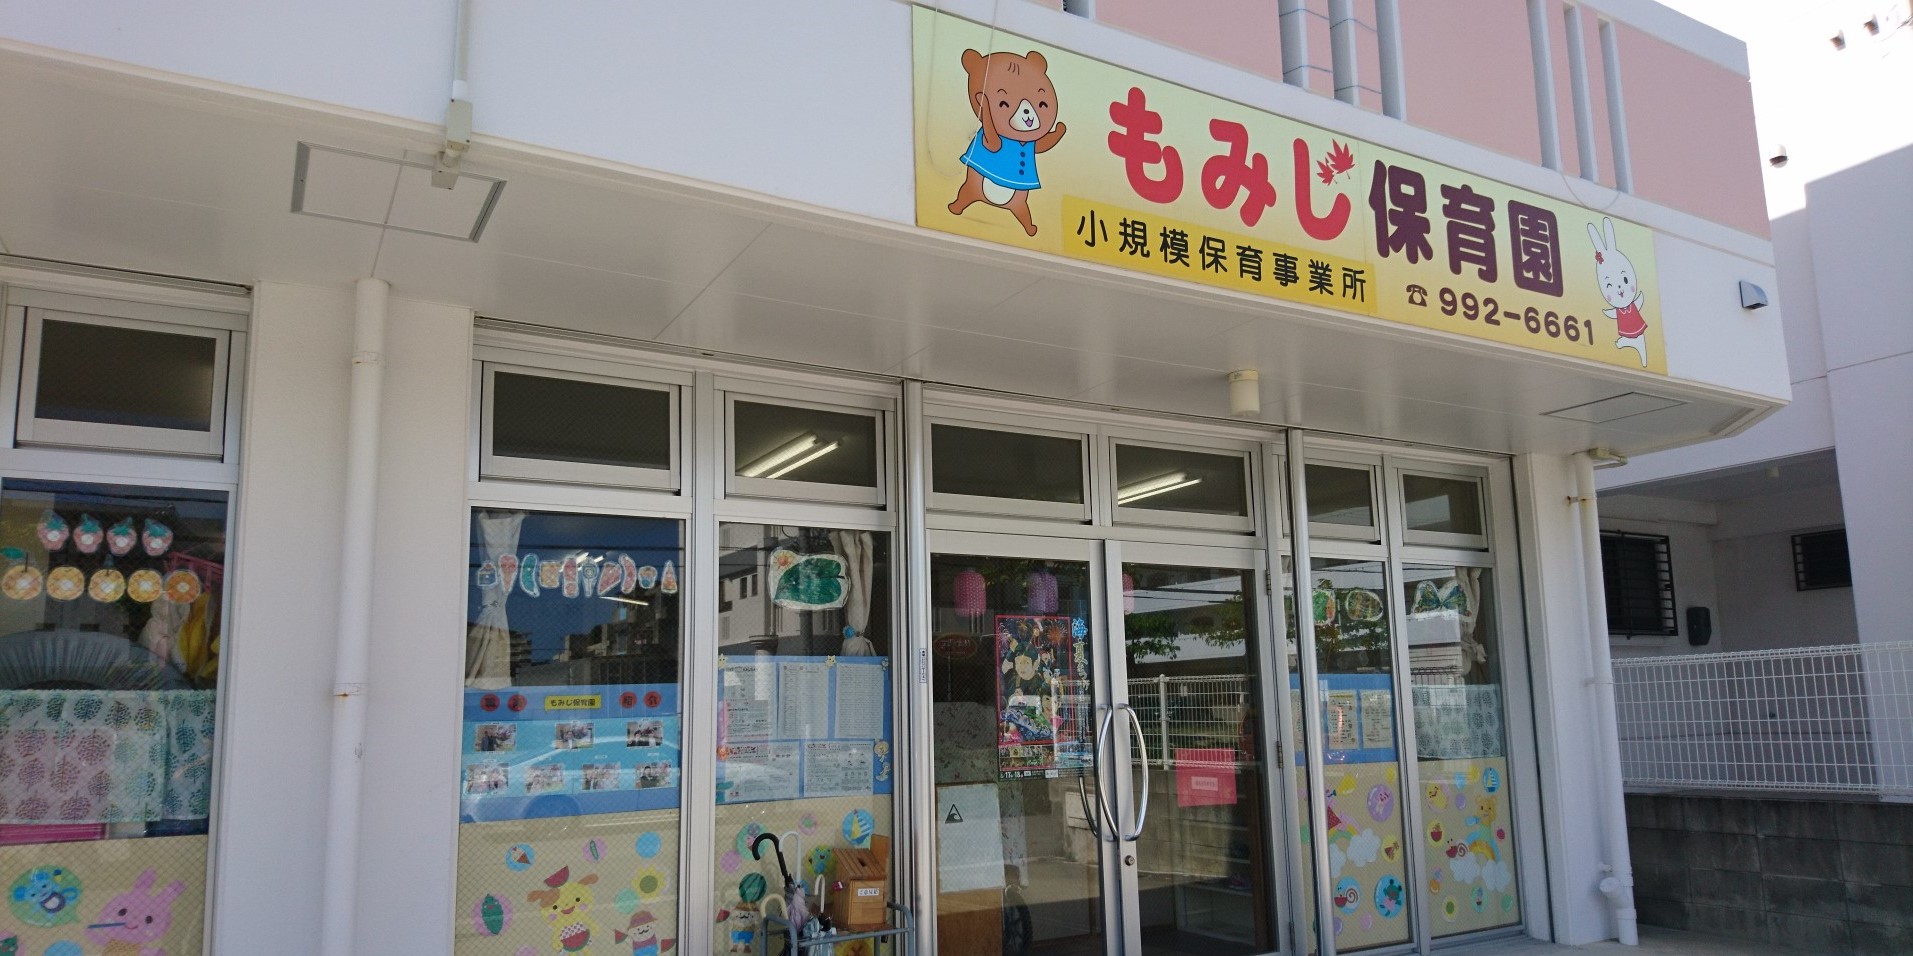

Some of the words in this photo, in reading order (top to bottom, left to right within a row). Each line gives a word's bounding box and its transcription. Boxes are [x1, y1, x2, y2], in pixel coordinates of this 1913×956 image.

[1107, 86, 1564, 298] もみじ保育園
[1076, 209, 1367, 303] 小規模保育事業所
[1438, 286, 1595, 346] 992-6661
[550, 698, 596, 707] もみじ保育園
